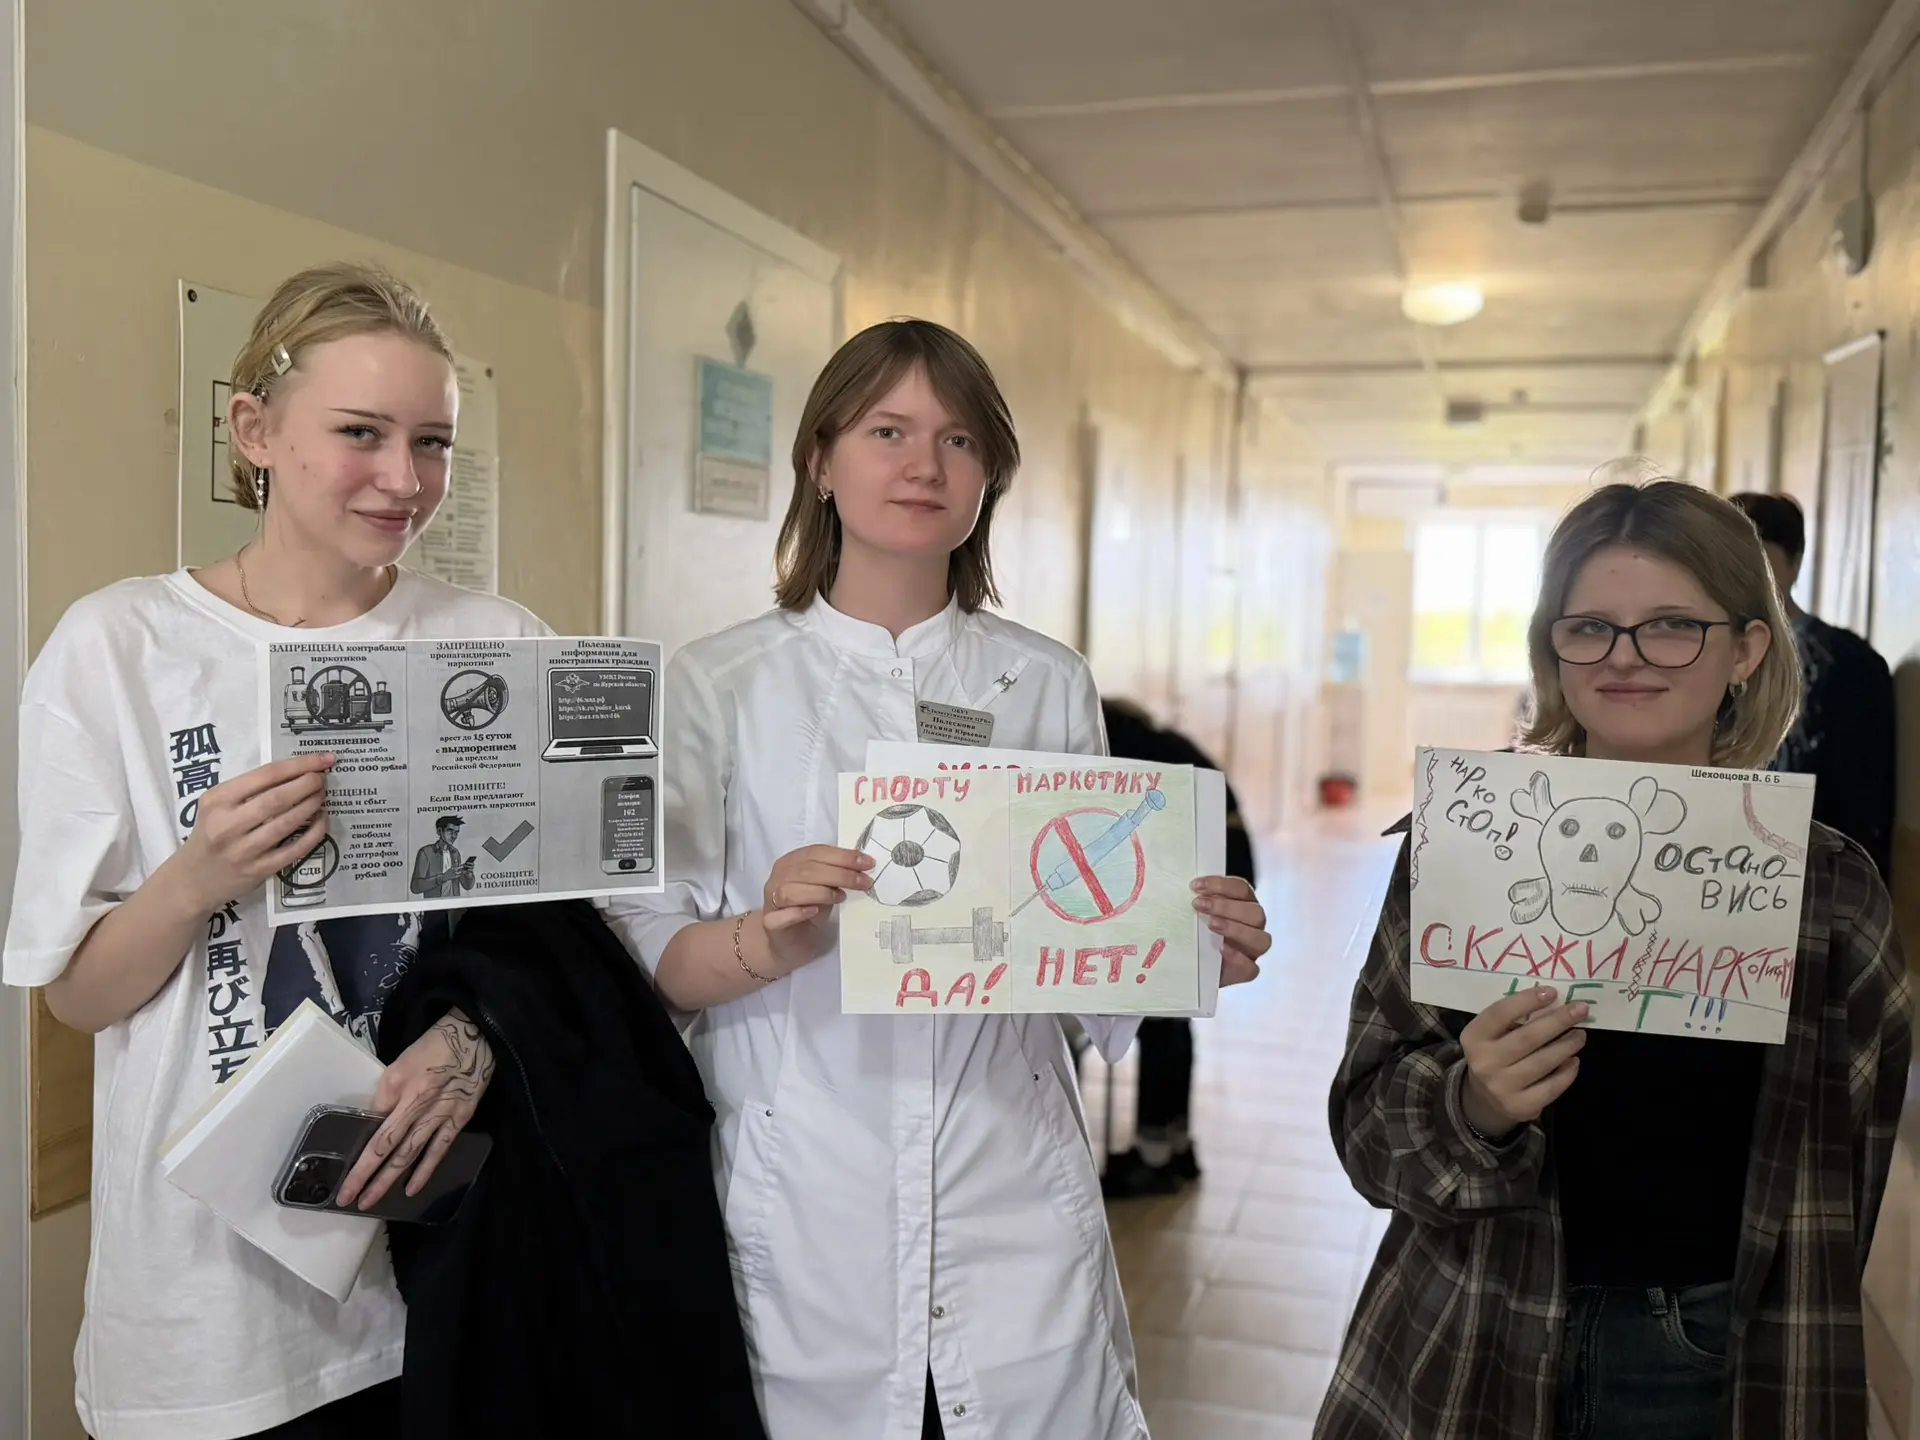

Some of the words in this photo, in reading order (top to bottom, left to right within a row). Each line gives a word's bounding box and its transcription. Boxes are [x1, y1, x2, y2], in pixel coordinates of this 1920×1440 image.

[270, 644, 344, 653] ЗАПРЕЩЕНА
[346, 644, 406, 653] контрабанда
[436, 641, 505, 651] ЗАПРЕЩЕНО
[578, 640, 622, 649] Полезная
[430, 652, 512, 661] пропагандировать
[561, 649, 620, 658] информация
[621, 649, 638, 658] для
[310, 655, 367, 664] наркотиков
[549, 657, 610, 667] иностранных
[611, 658, 650, 667] граждан
[299, 737, 380, 746] пожизненное
[473, 733, 485, 742] 15
[485, 732, 513, 742] суток
[367, 746, 389, 754] либо
[441, 743, 518, 756] выдворением
[360, 756, 396, 764] свободы
[465, 754, 499, 763] пределы
[358, 765, 380, 773] 000
[380, 763, 408, 773] рублей
[432, 763, 477, 771] Российской
[478, 761, 522, 771] Федерации
[1691, 768, 1750, 782] Шеховцова
[1752, 773, 1762, 783] В.
[448, 782, 506, 792] ПОМНИТЕ!
[1016, 770, 1163, 796] НАРКОТИКУ
[325, 788, 378, 798] РЕЩЕНЫ
[854, 774, 971, 806] СПОРТУ
[429, 794, 452, 803] Если
[453, 794, 471, 802] Вам
[472, 792, 525, 801] предлагают
[321, 800, 353, 808] абанда
[363, 798, 388, 806] сбыт
[417, 804, 487, 814] распространять
[488, 800, 536, 809] наркотики
[366, 806, 400, 814] веществ
[349, 822, 393, 830] лишение
[351, 831, 391, 840] свободы
[375, 841, 394, 849] лет
[355, 850, 400, 860] штрафом
[299, 866, 321, 876] СДВ
[338, 864, 350, 872] до
[360, 861, 381, 869] 000
[382, 860, 403, 868] 000
[354, 871, 388, 881] рублей
[480, 870, 534, 880] СООБЩИТЕ
[1700, 879, 1788, 916] ВИСЬ
[1420, 921, 1630, 981] СКАЖИ
[1036, 937, 1167, 988] НЕТ!
[895, 962, 1008, 1009] ДА!
